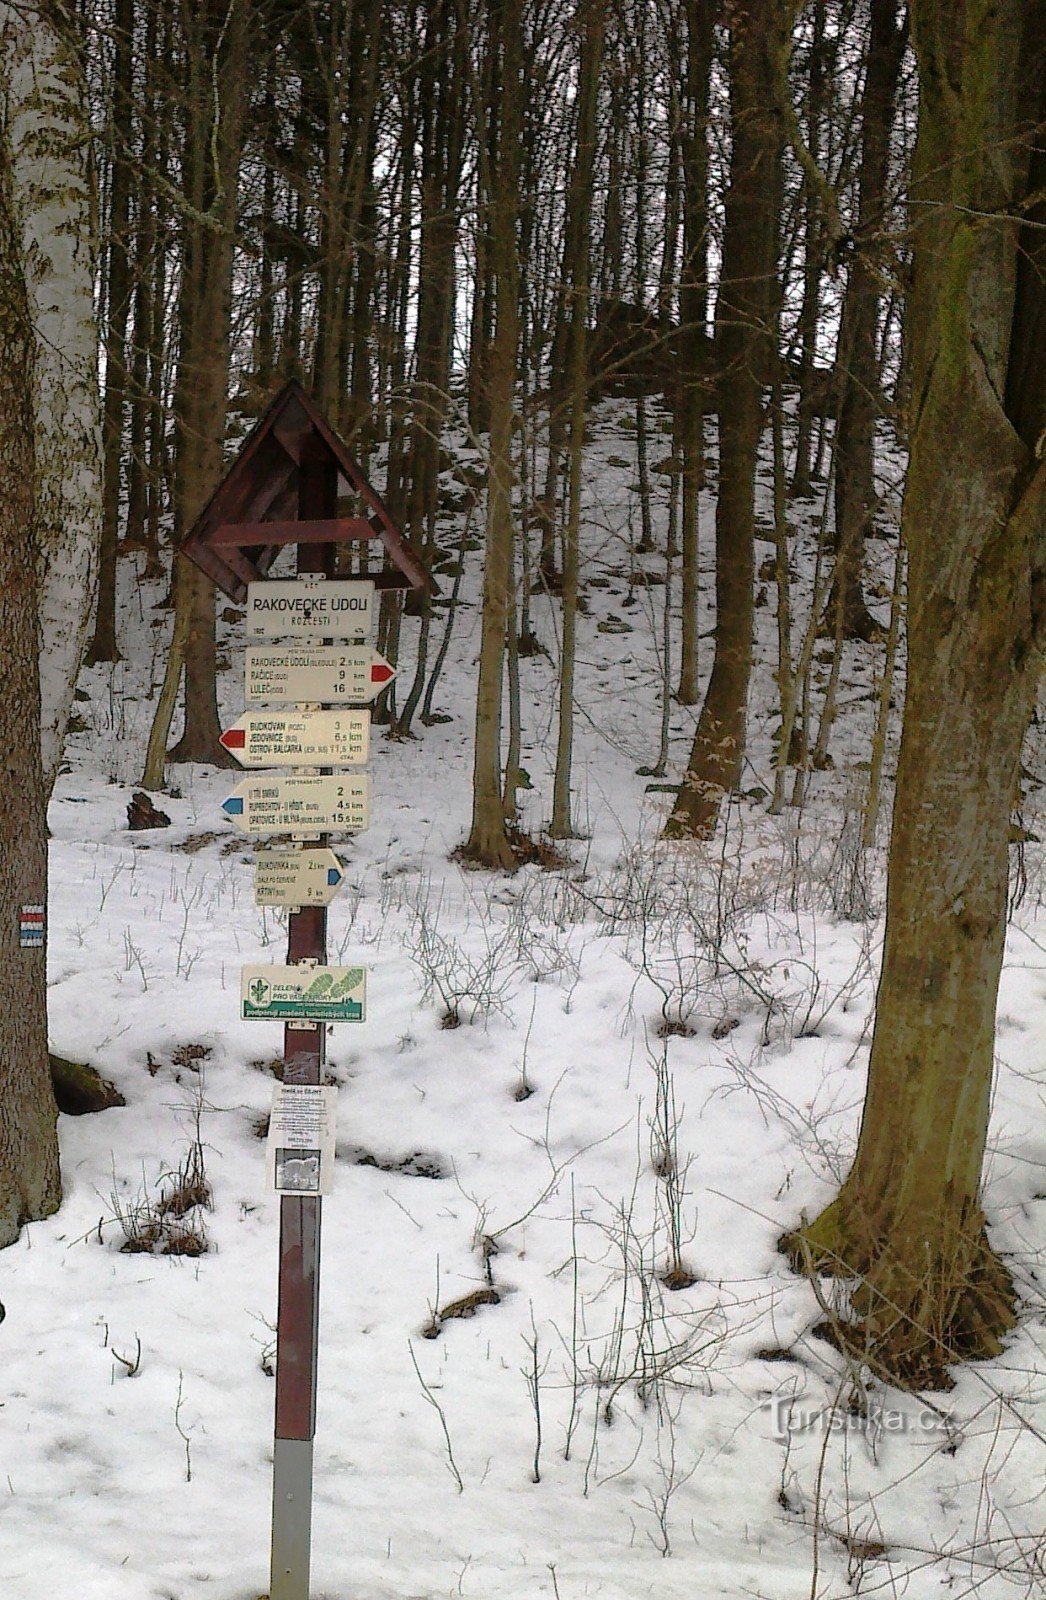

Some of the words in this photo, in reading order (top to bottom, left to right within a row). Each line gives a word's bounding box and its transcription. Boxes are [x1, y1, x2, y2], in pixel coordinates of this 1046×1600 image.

[353, 659, 366, 667] km
[339, 670, 346, 680] 9
[353, 672, 366, 680] km
[333, 683, 345, 693] 16
[334, 721, 341, 731] 3
[349, 721, 363, 730] km
[249, 732, 283, 743] JEDOVNICE
[349, 731, 363, 741] km
[349, 744, 363, 753] km
[337, 787, 344, 796] 2
[351, 788, 363, 796] km
[351, 801, 364, 809] km
[351, 814, 364, 822] km
[307, 887, 312, 896] 9
